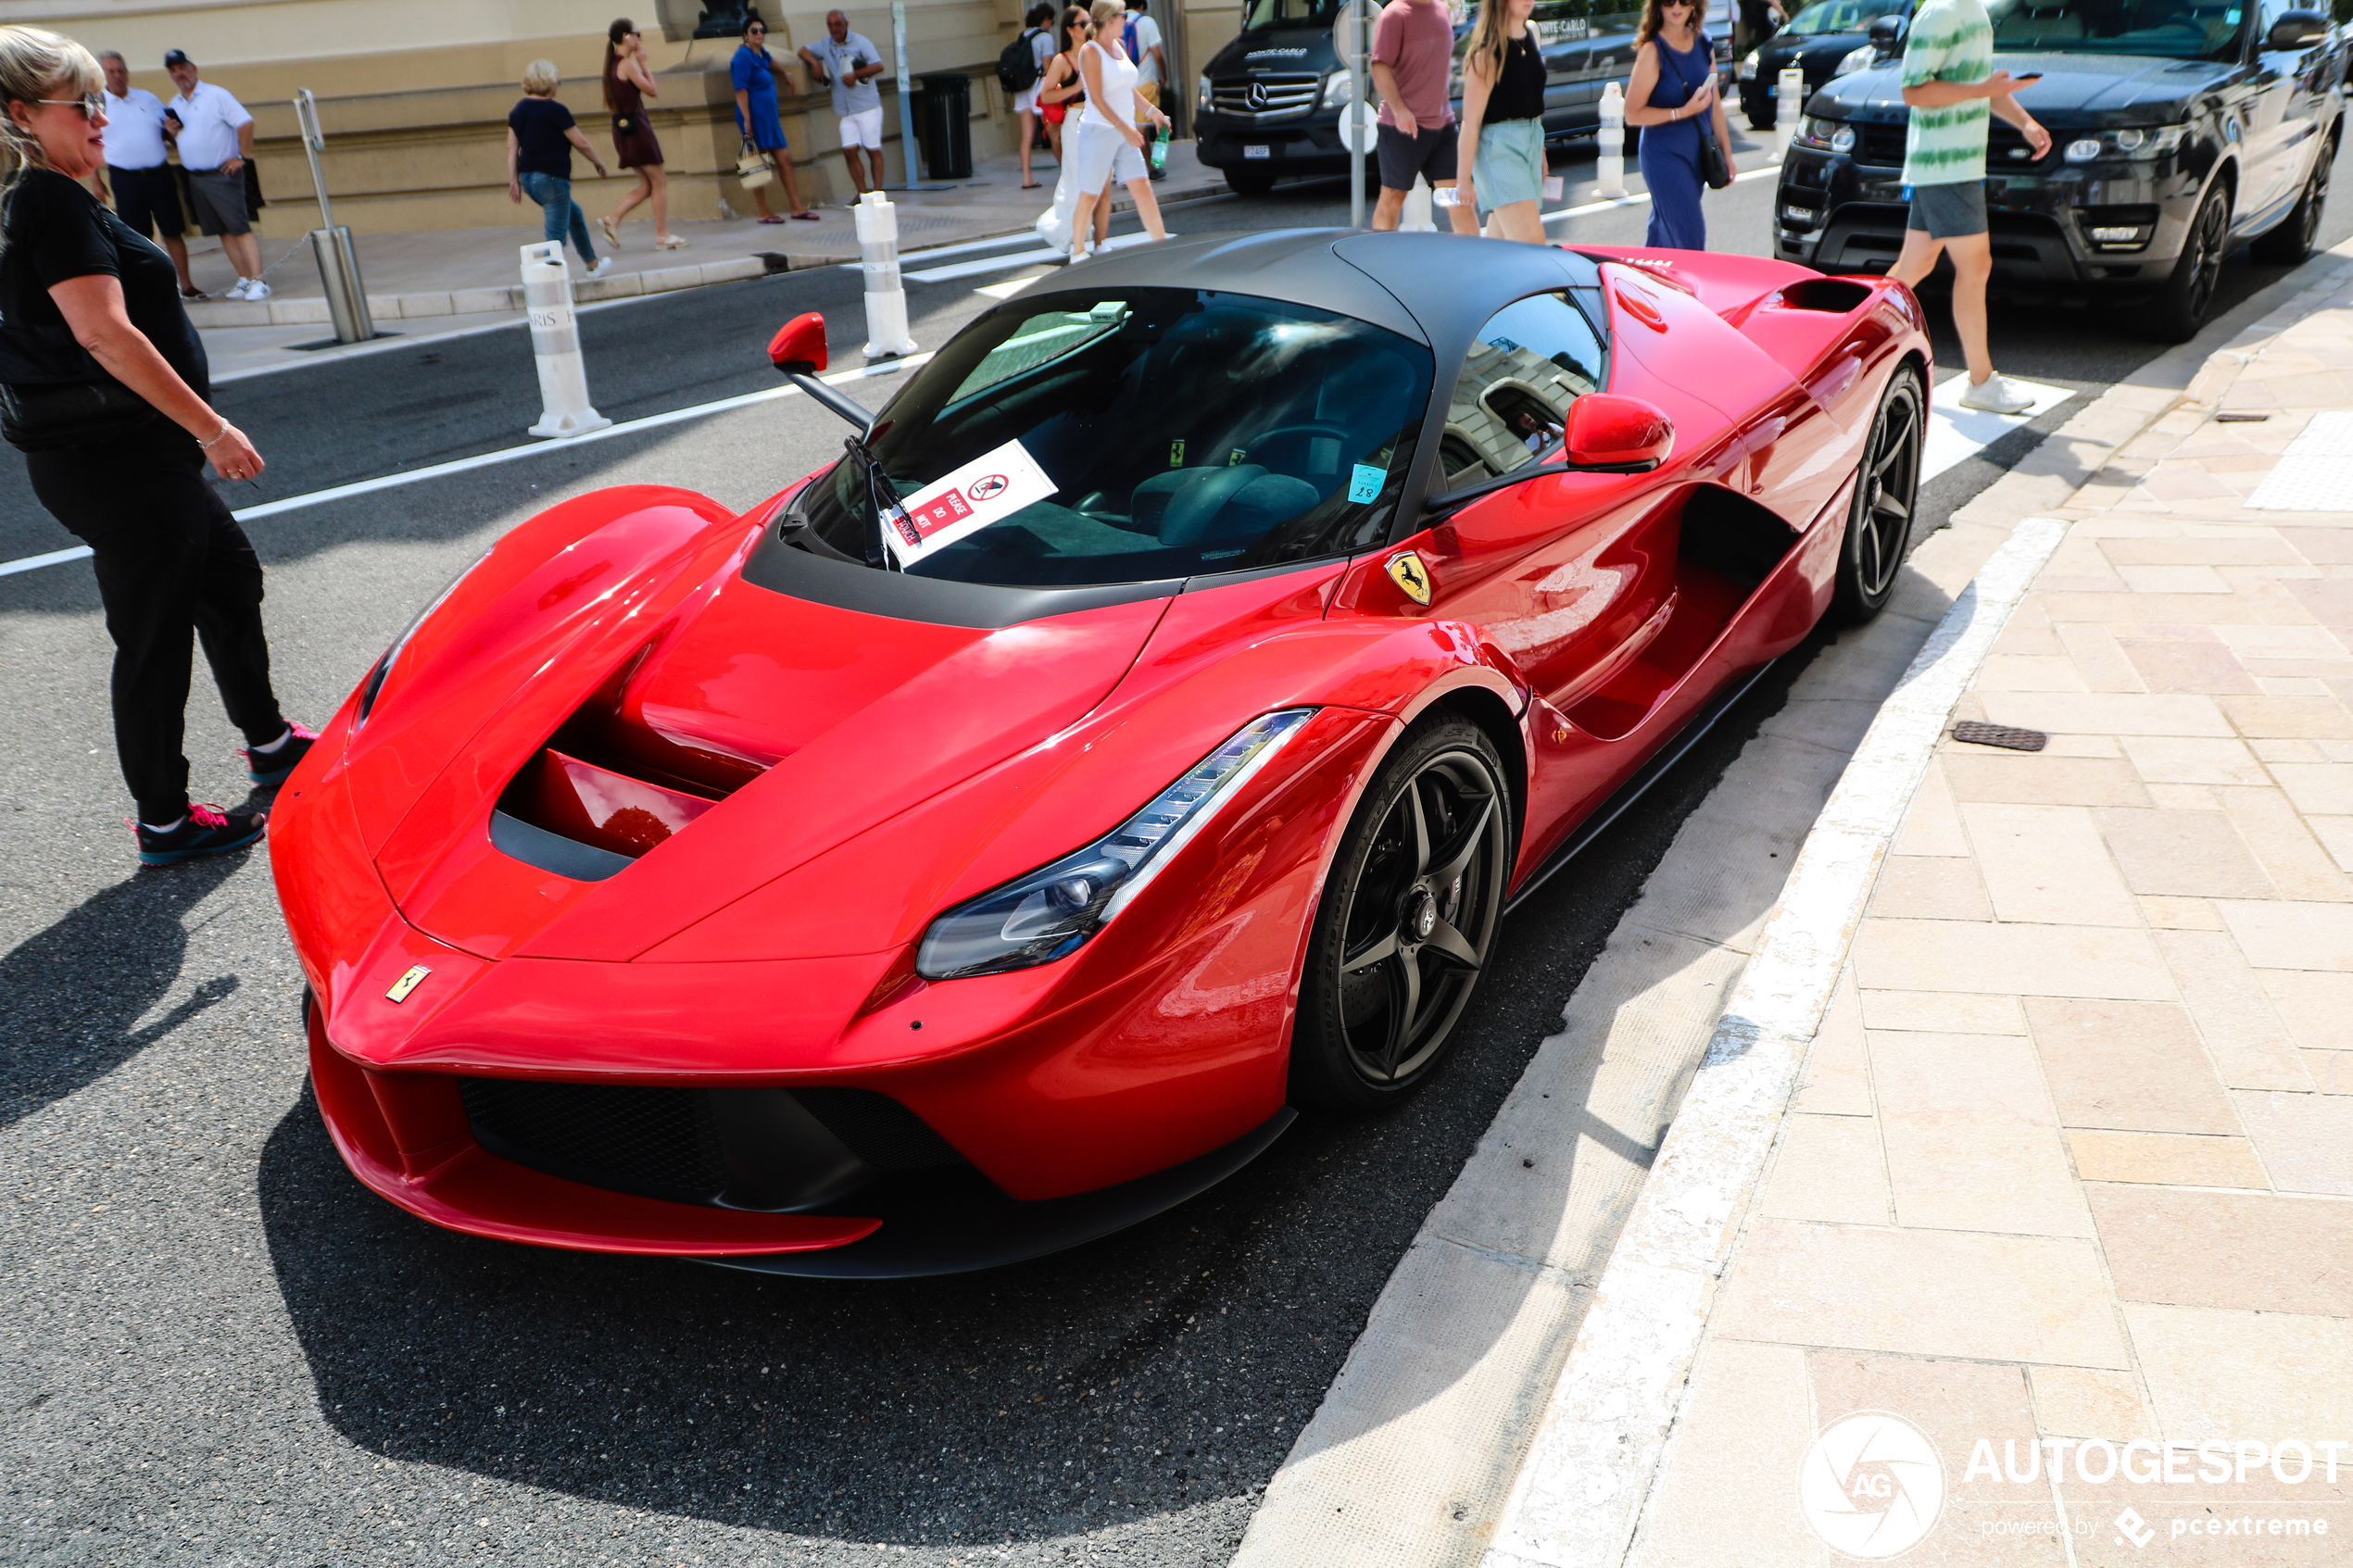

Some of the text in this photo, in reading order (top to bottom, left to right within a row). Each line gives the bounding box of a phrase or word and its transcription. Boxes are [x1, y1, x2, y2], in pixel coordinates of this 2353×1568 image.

[1355, 486, 1374, 497] 28
[945, 493, 968, 516] PLEASE
[915, 513, 932, 529] NOT
[933, 507, 947, 519] DO
[897, 520, 916, 542] TOUCH
